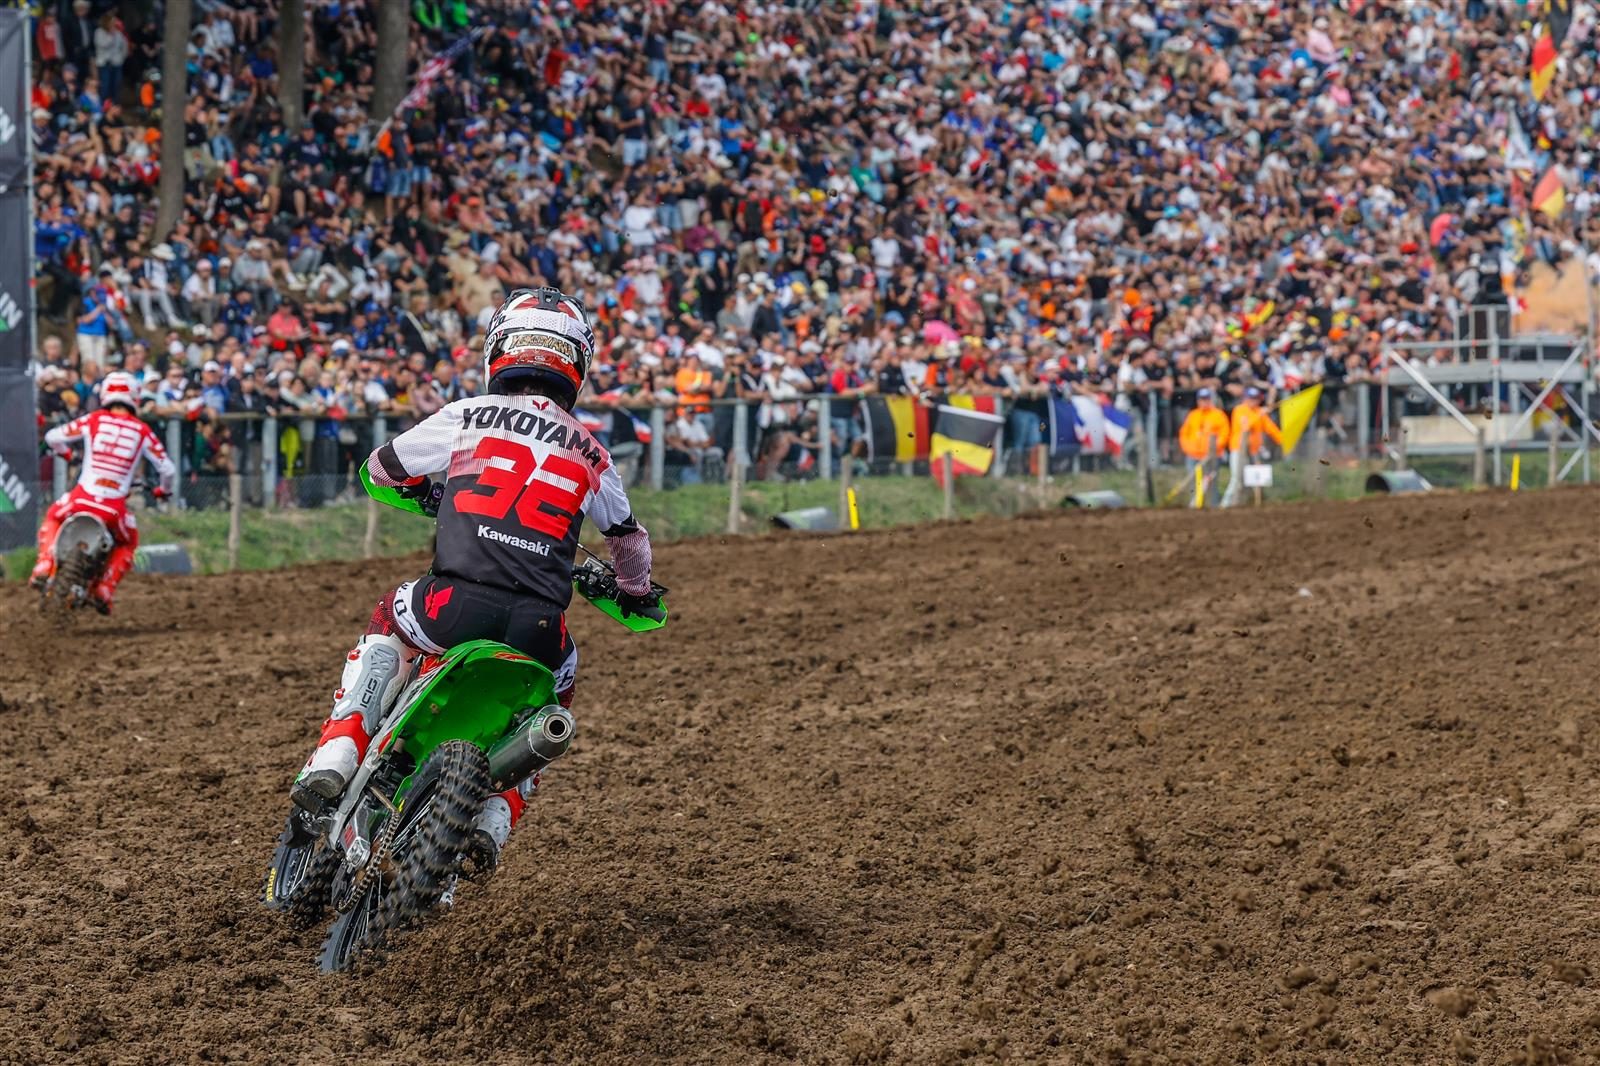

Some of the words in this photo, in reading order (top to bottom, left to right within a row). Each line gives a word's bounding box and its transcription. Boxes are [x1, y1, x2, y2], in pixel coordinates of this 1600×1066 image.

[93, 423, 142, 460] 23
[462, 406, 602, 468] YOKOYAMA
[0, 461, 31, 510] LIN
[453, 436, 588, 541] 32
[477, 524, 550, 557] Kawasaki
